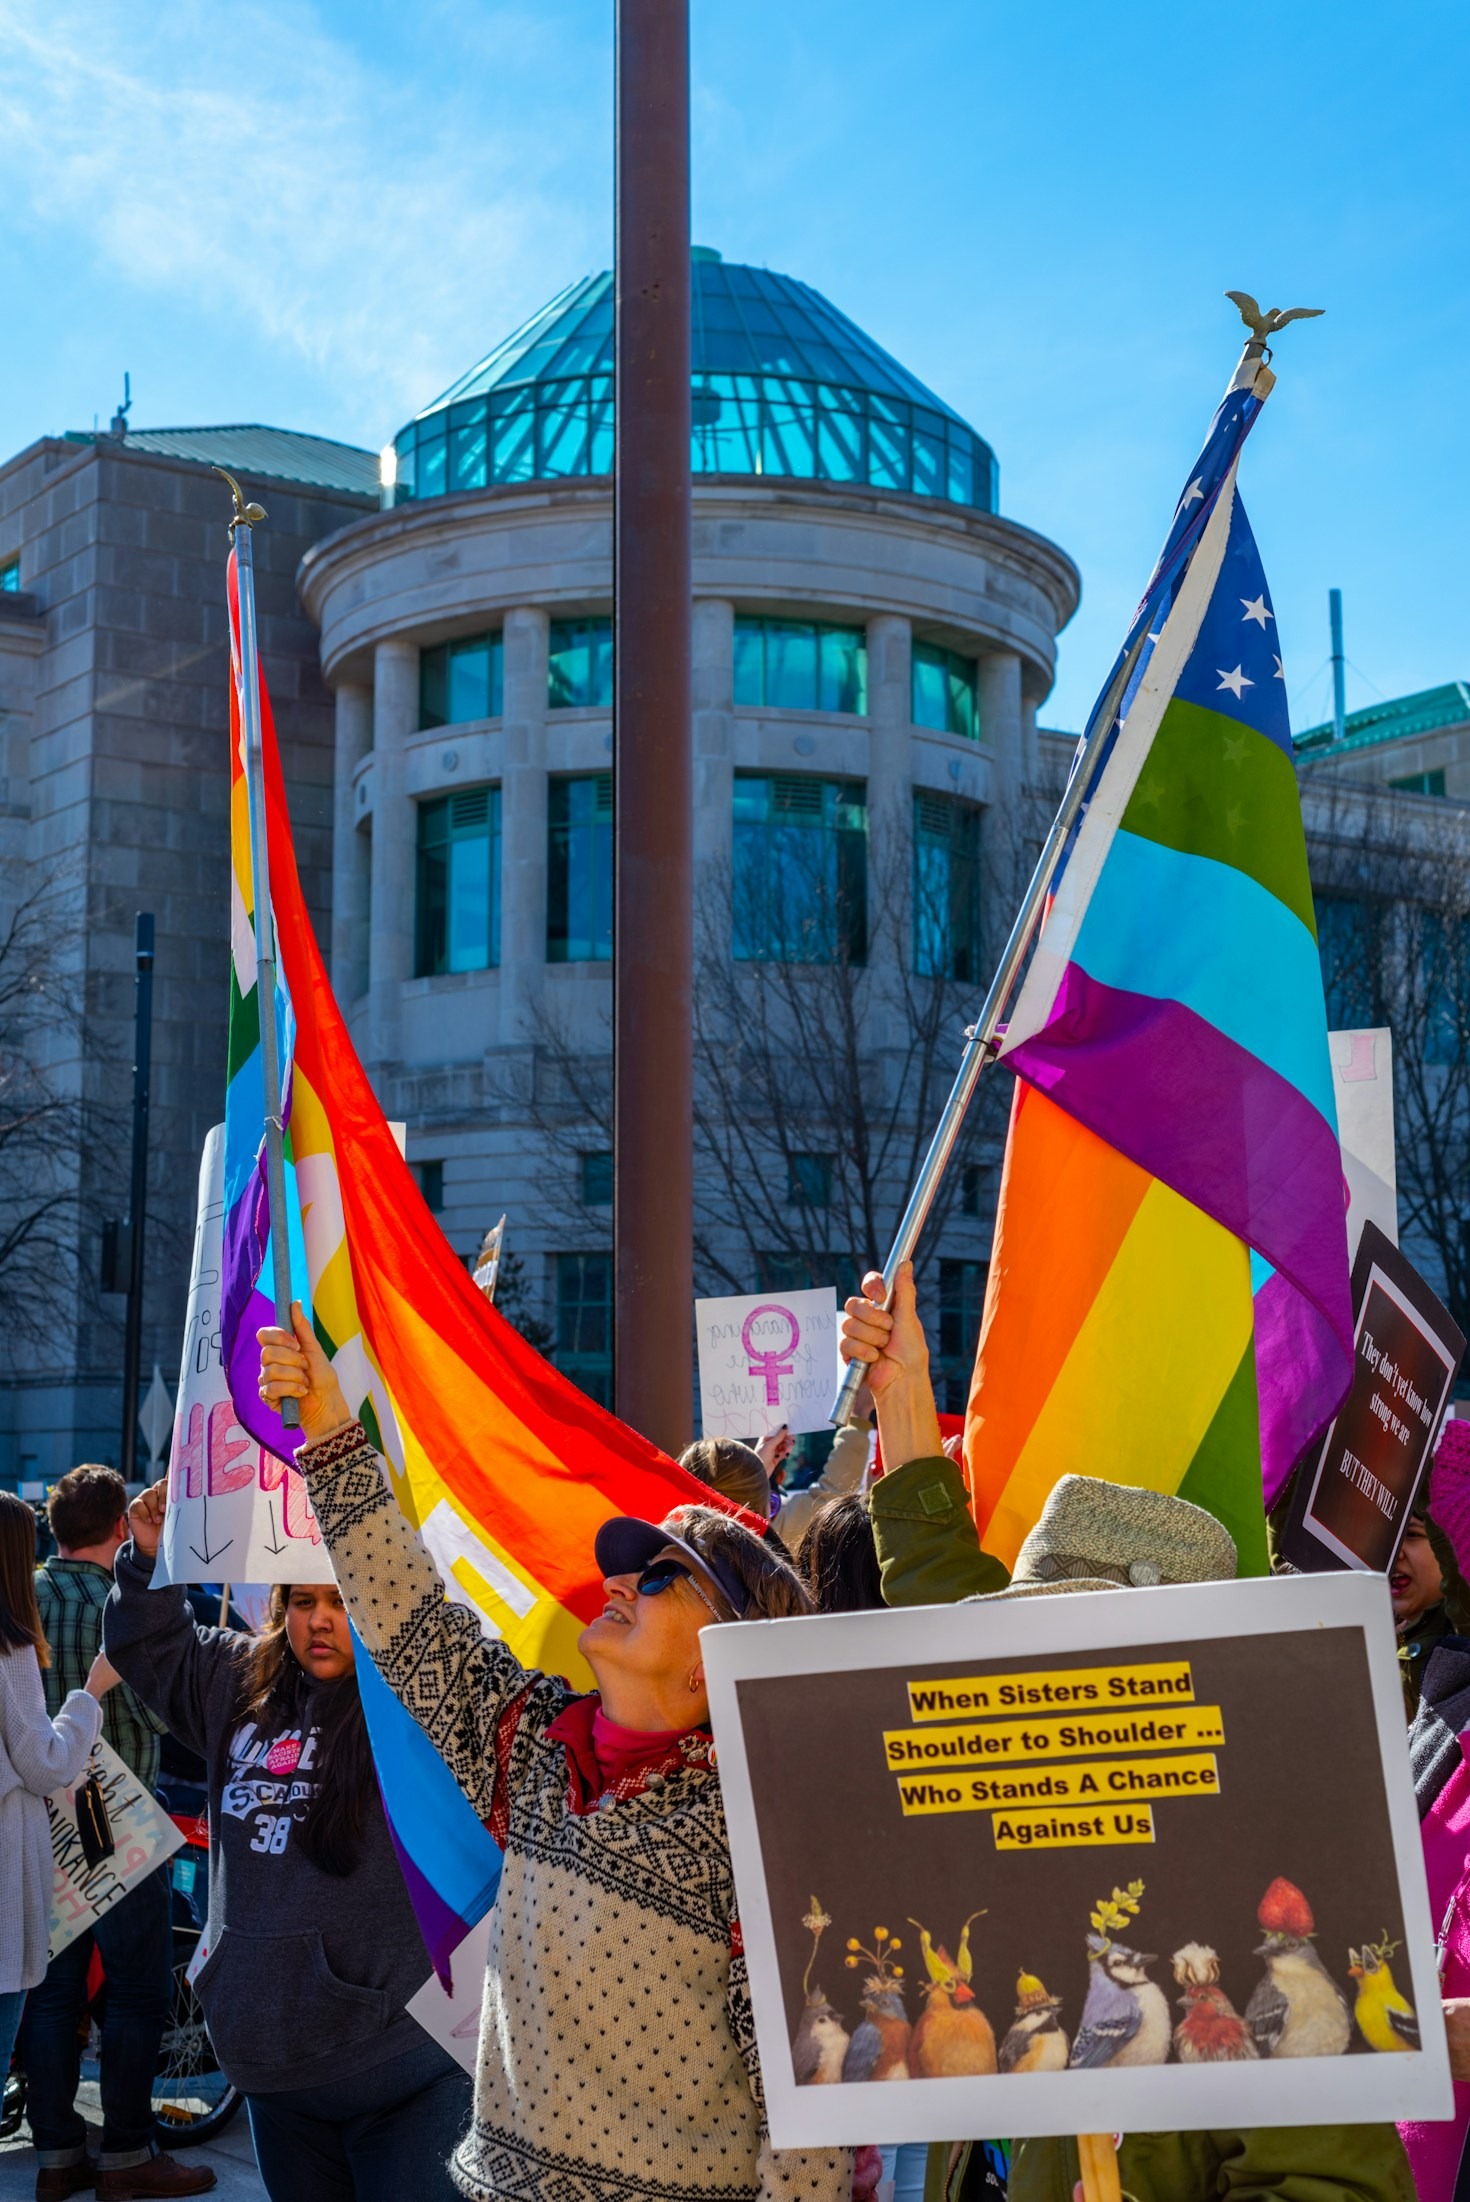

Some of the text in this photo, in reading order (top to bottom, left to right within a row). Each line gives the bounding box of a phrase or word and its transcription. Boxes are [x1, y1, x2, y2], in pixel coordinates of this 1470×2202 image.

[1361, 1330, 1434, 1428] They don't yet know how
[1369, 1391, 1411, 1447] strong we are
[1339, 1448, 1399, 1521] BUT THEY WILL!
[911, 1672, 1192, 1712] When Sisters Stand
[273, 1743, 298, 1754] MAKE
[888, 1734, 1012, 1761] Shoulder
[1021, 1731, 1050, 1751] to
[1059, 1721, 1187, 1749] Shoulder
[271, 1758, 298, 1769] AGAIN
[901, 1767, 1216, 1806] Who Stands A Chance
[249, 1813, 292, 1855] 38
[996, 1814, 1151, 1844] Against Us
